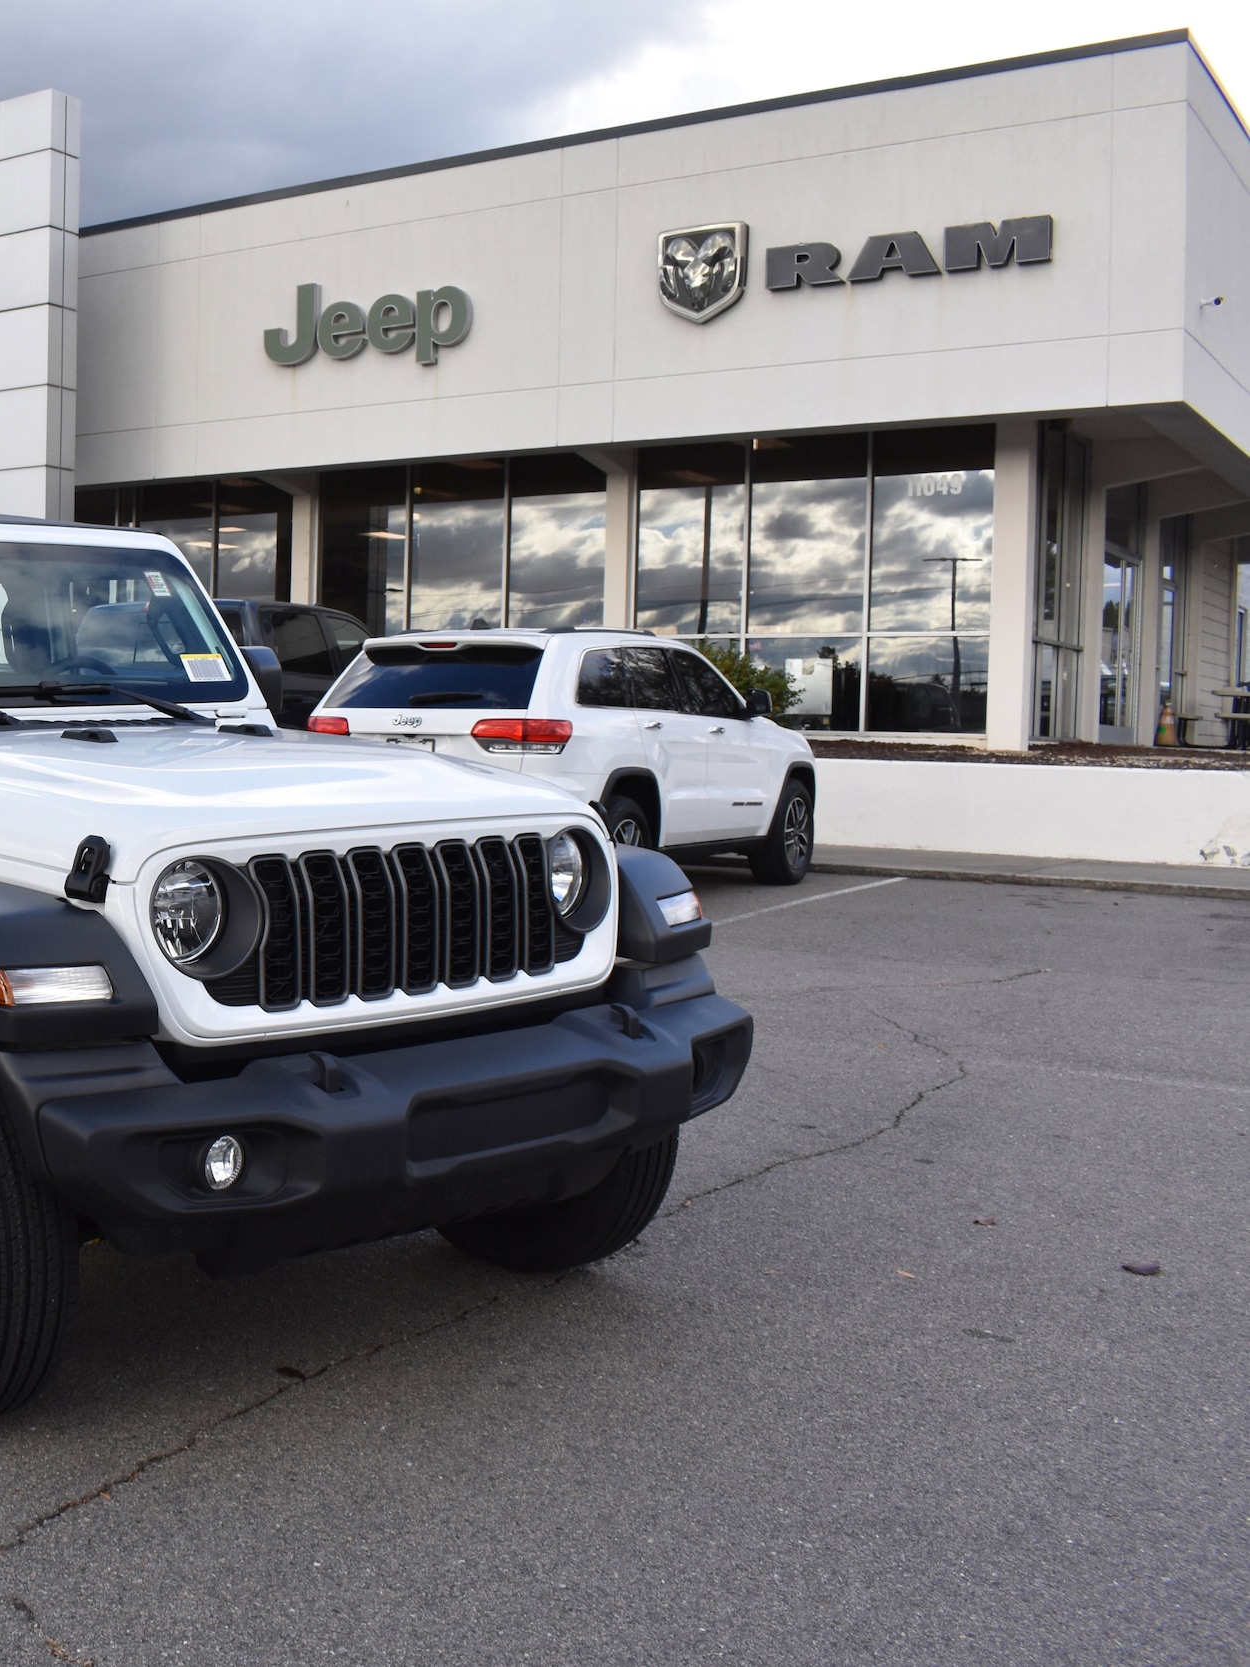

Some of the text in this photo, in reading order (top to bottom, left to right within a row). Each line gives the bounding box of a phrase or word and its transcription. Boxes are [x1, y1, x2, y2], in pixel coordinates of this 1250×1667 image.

[765, 214, 1054, 292] RAM
[263, 283, 474, 366] Jeep
[907, 473, 963, 497] 11049
[392, 714, 423, 728] Jeep
